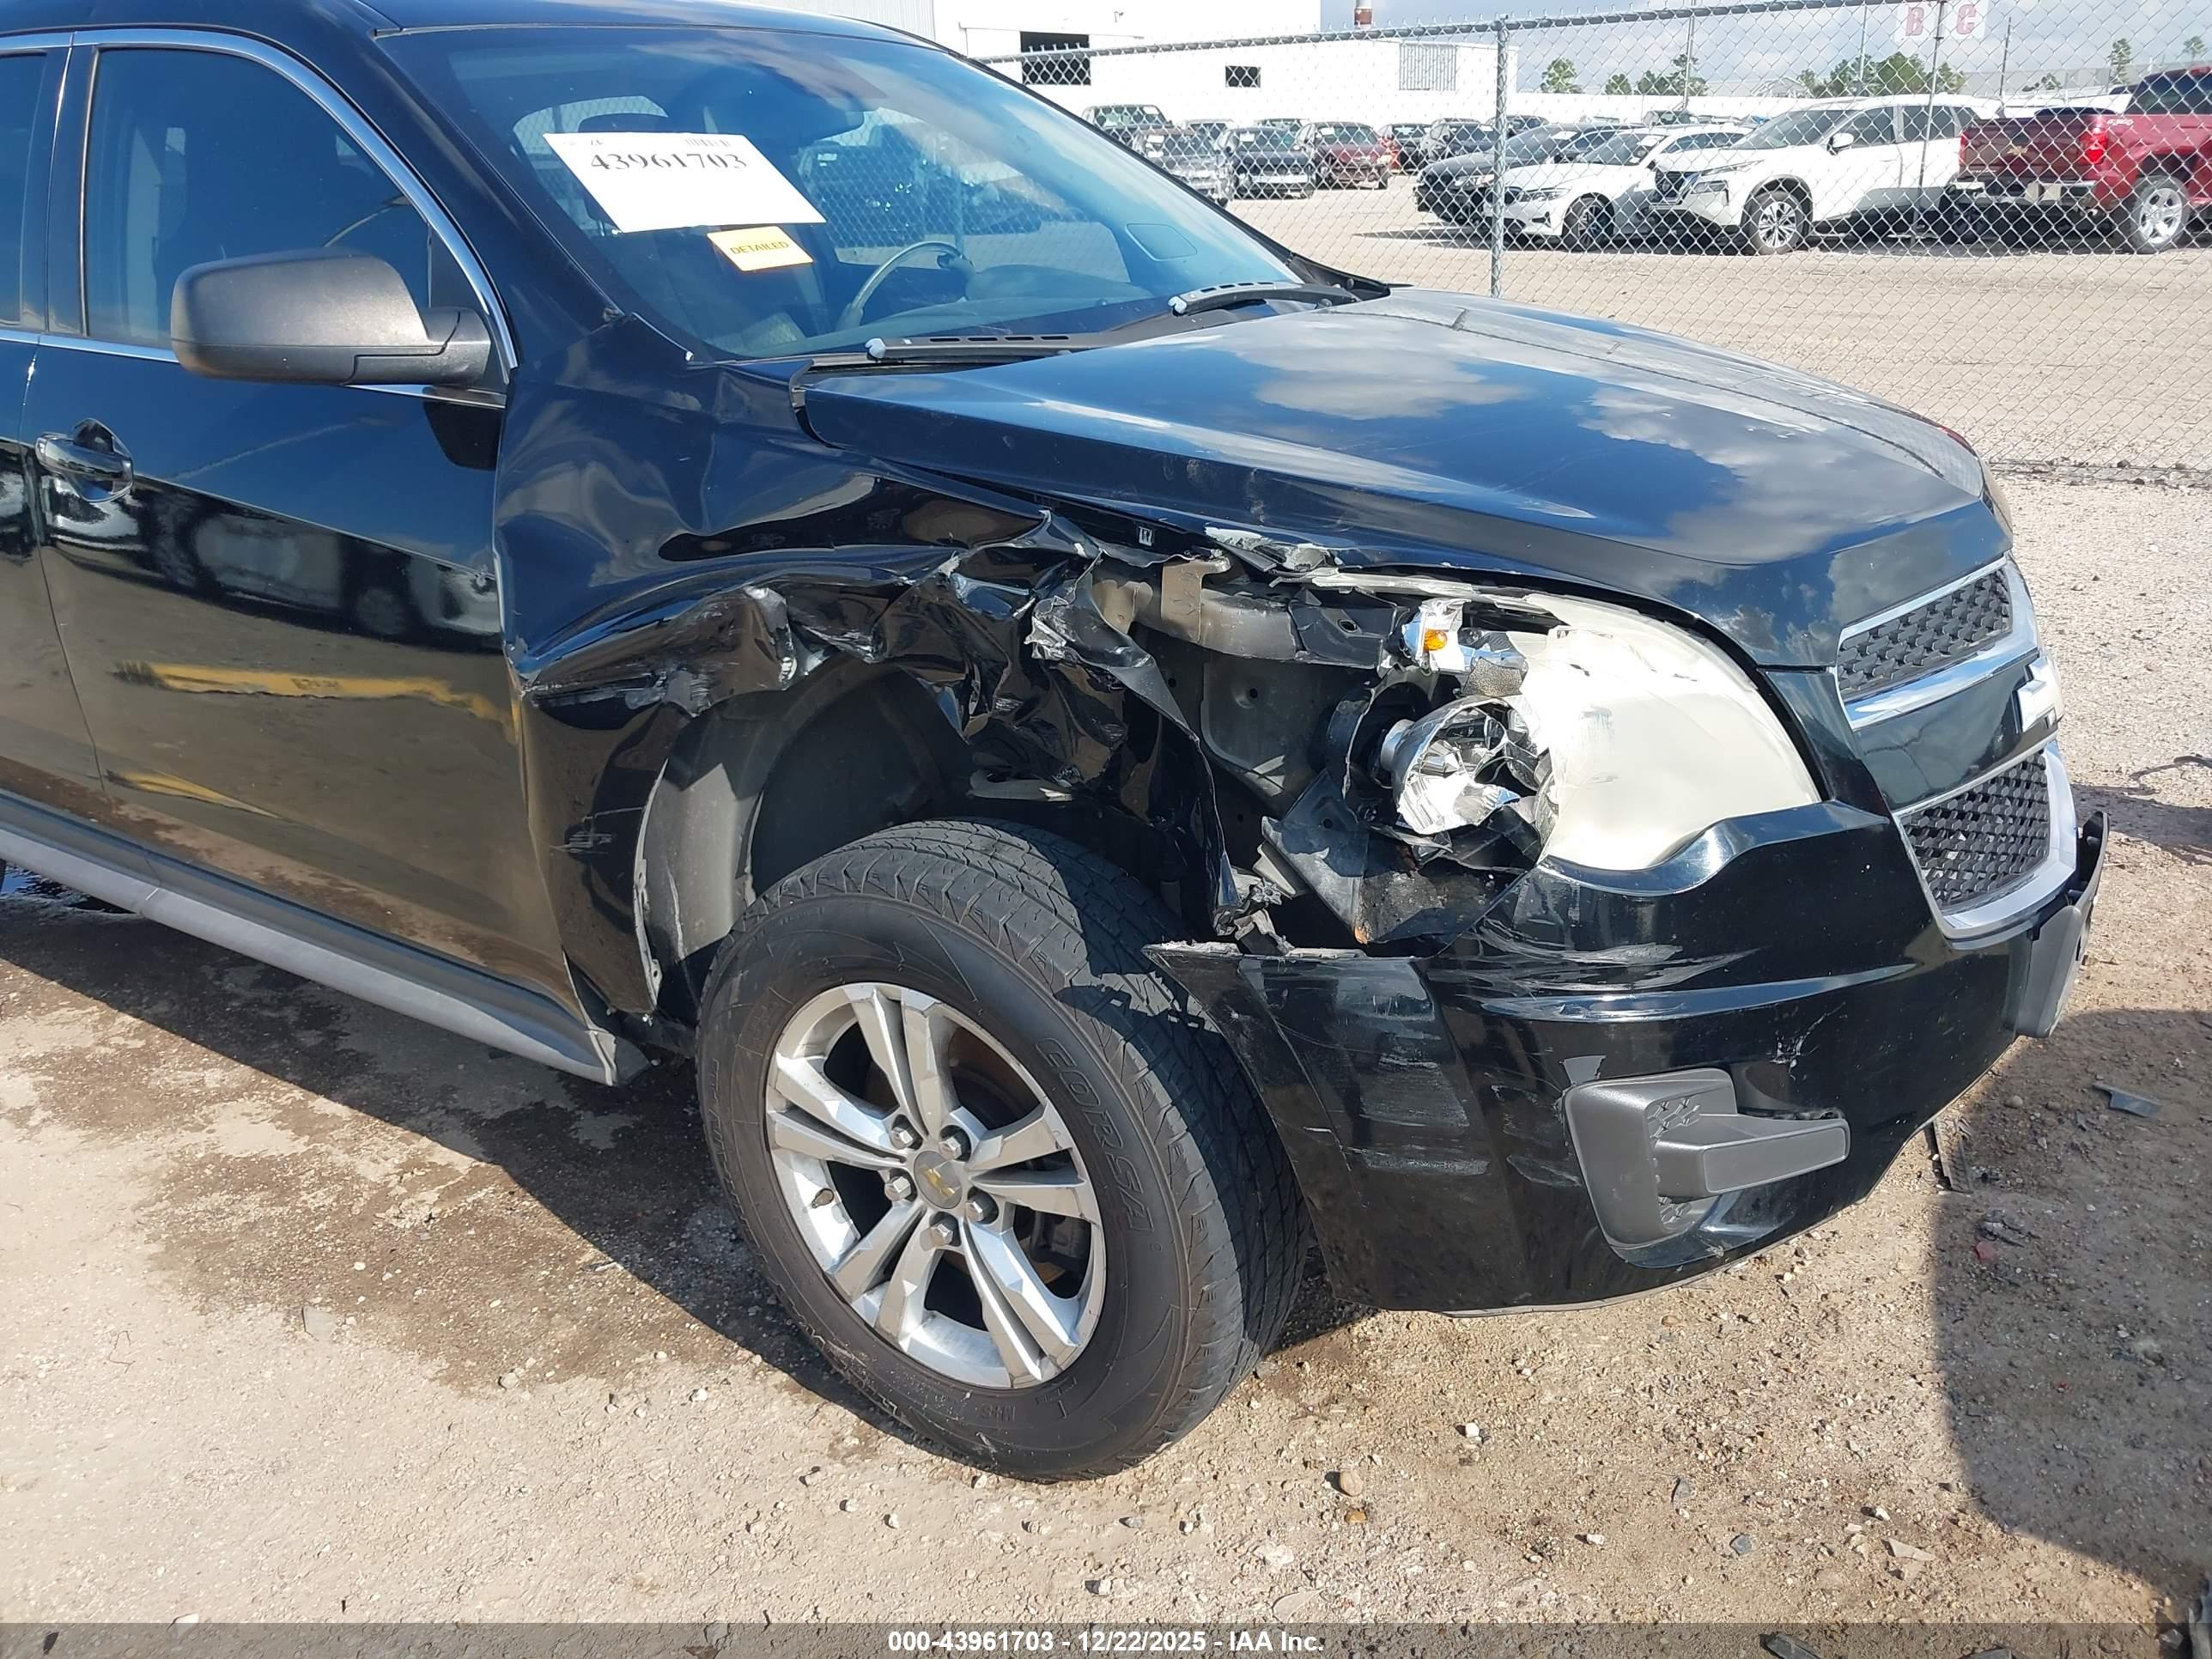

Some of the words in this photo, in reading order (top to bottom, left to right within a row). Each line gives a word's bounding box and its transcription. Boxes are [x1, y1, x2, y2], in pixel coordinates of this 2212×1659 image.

[1905, 7, 1924, 36] B
[591, 153, 748, 169] 43961703
[730, 241, 788, 254] DETAILED
[1035, 1037, 1155, 1231] CORSA
